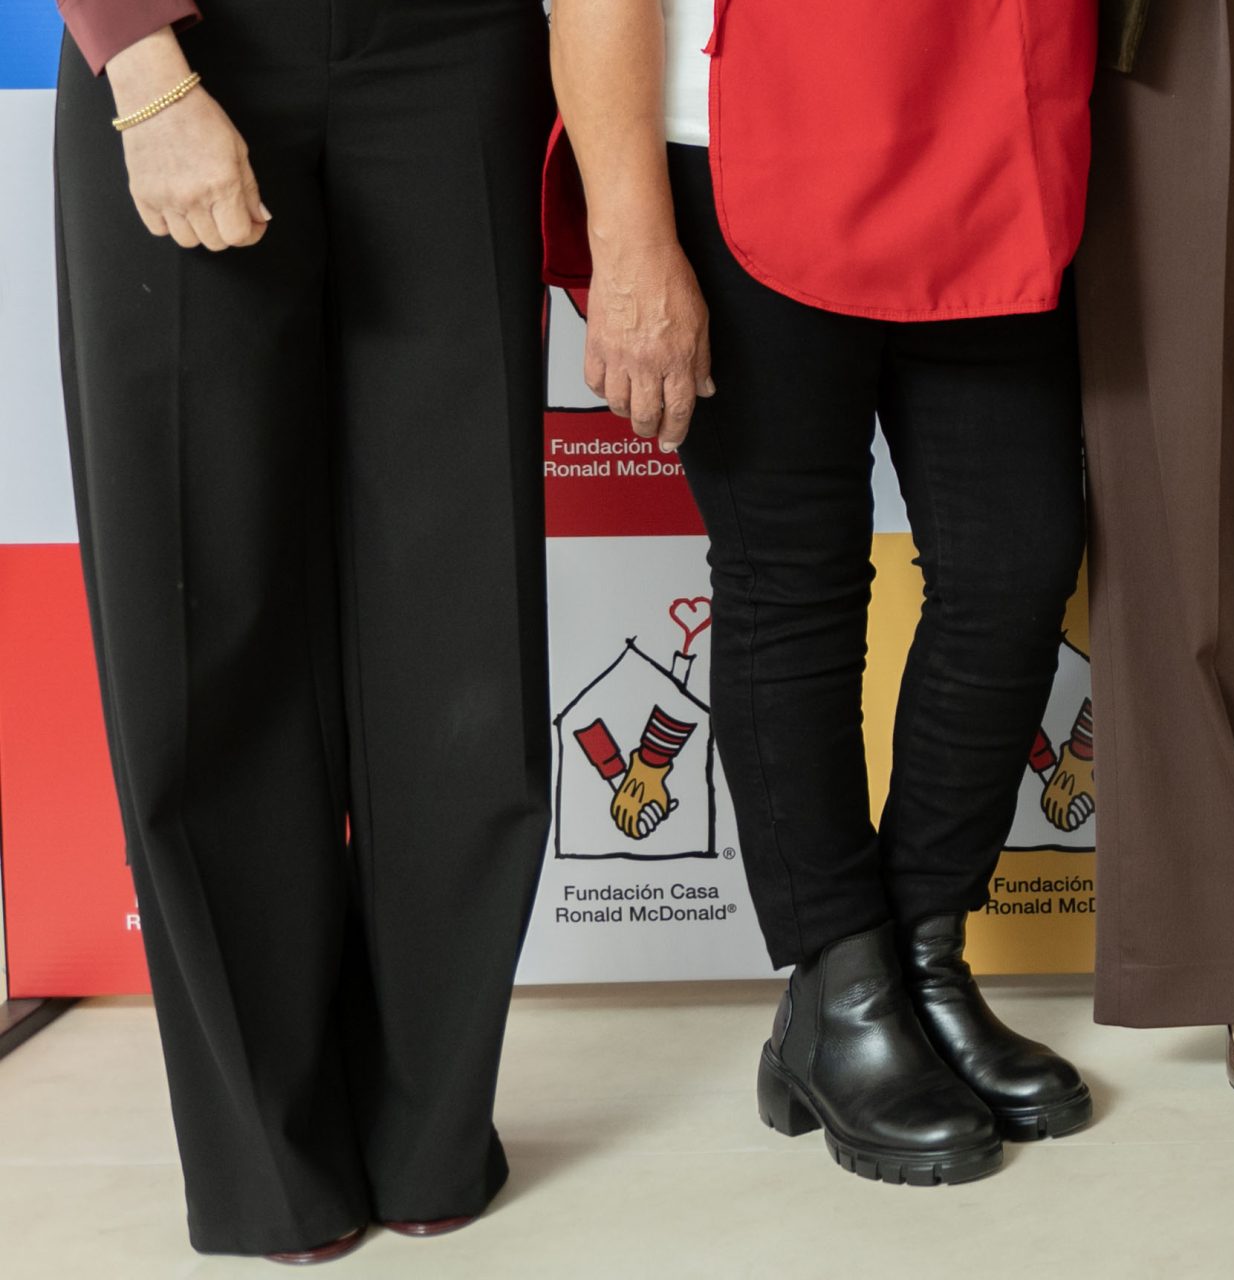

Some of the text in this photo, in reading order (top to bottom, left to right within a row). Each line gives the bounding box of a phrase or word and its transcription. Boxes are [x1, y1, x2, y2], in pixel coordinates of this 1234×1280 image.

[551, 438, 653, 455] Fundación
[543, 460, 686, 477] Ronald McDon
[564, 883, 720, 901] Fundación Casa
[994, 876, 1094, 893] Fundación
[556, 907, 622, 923] Ronald
[986, 898, 1052, 915] Ronald
